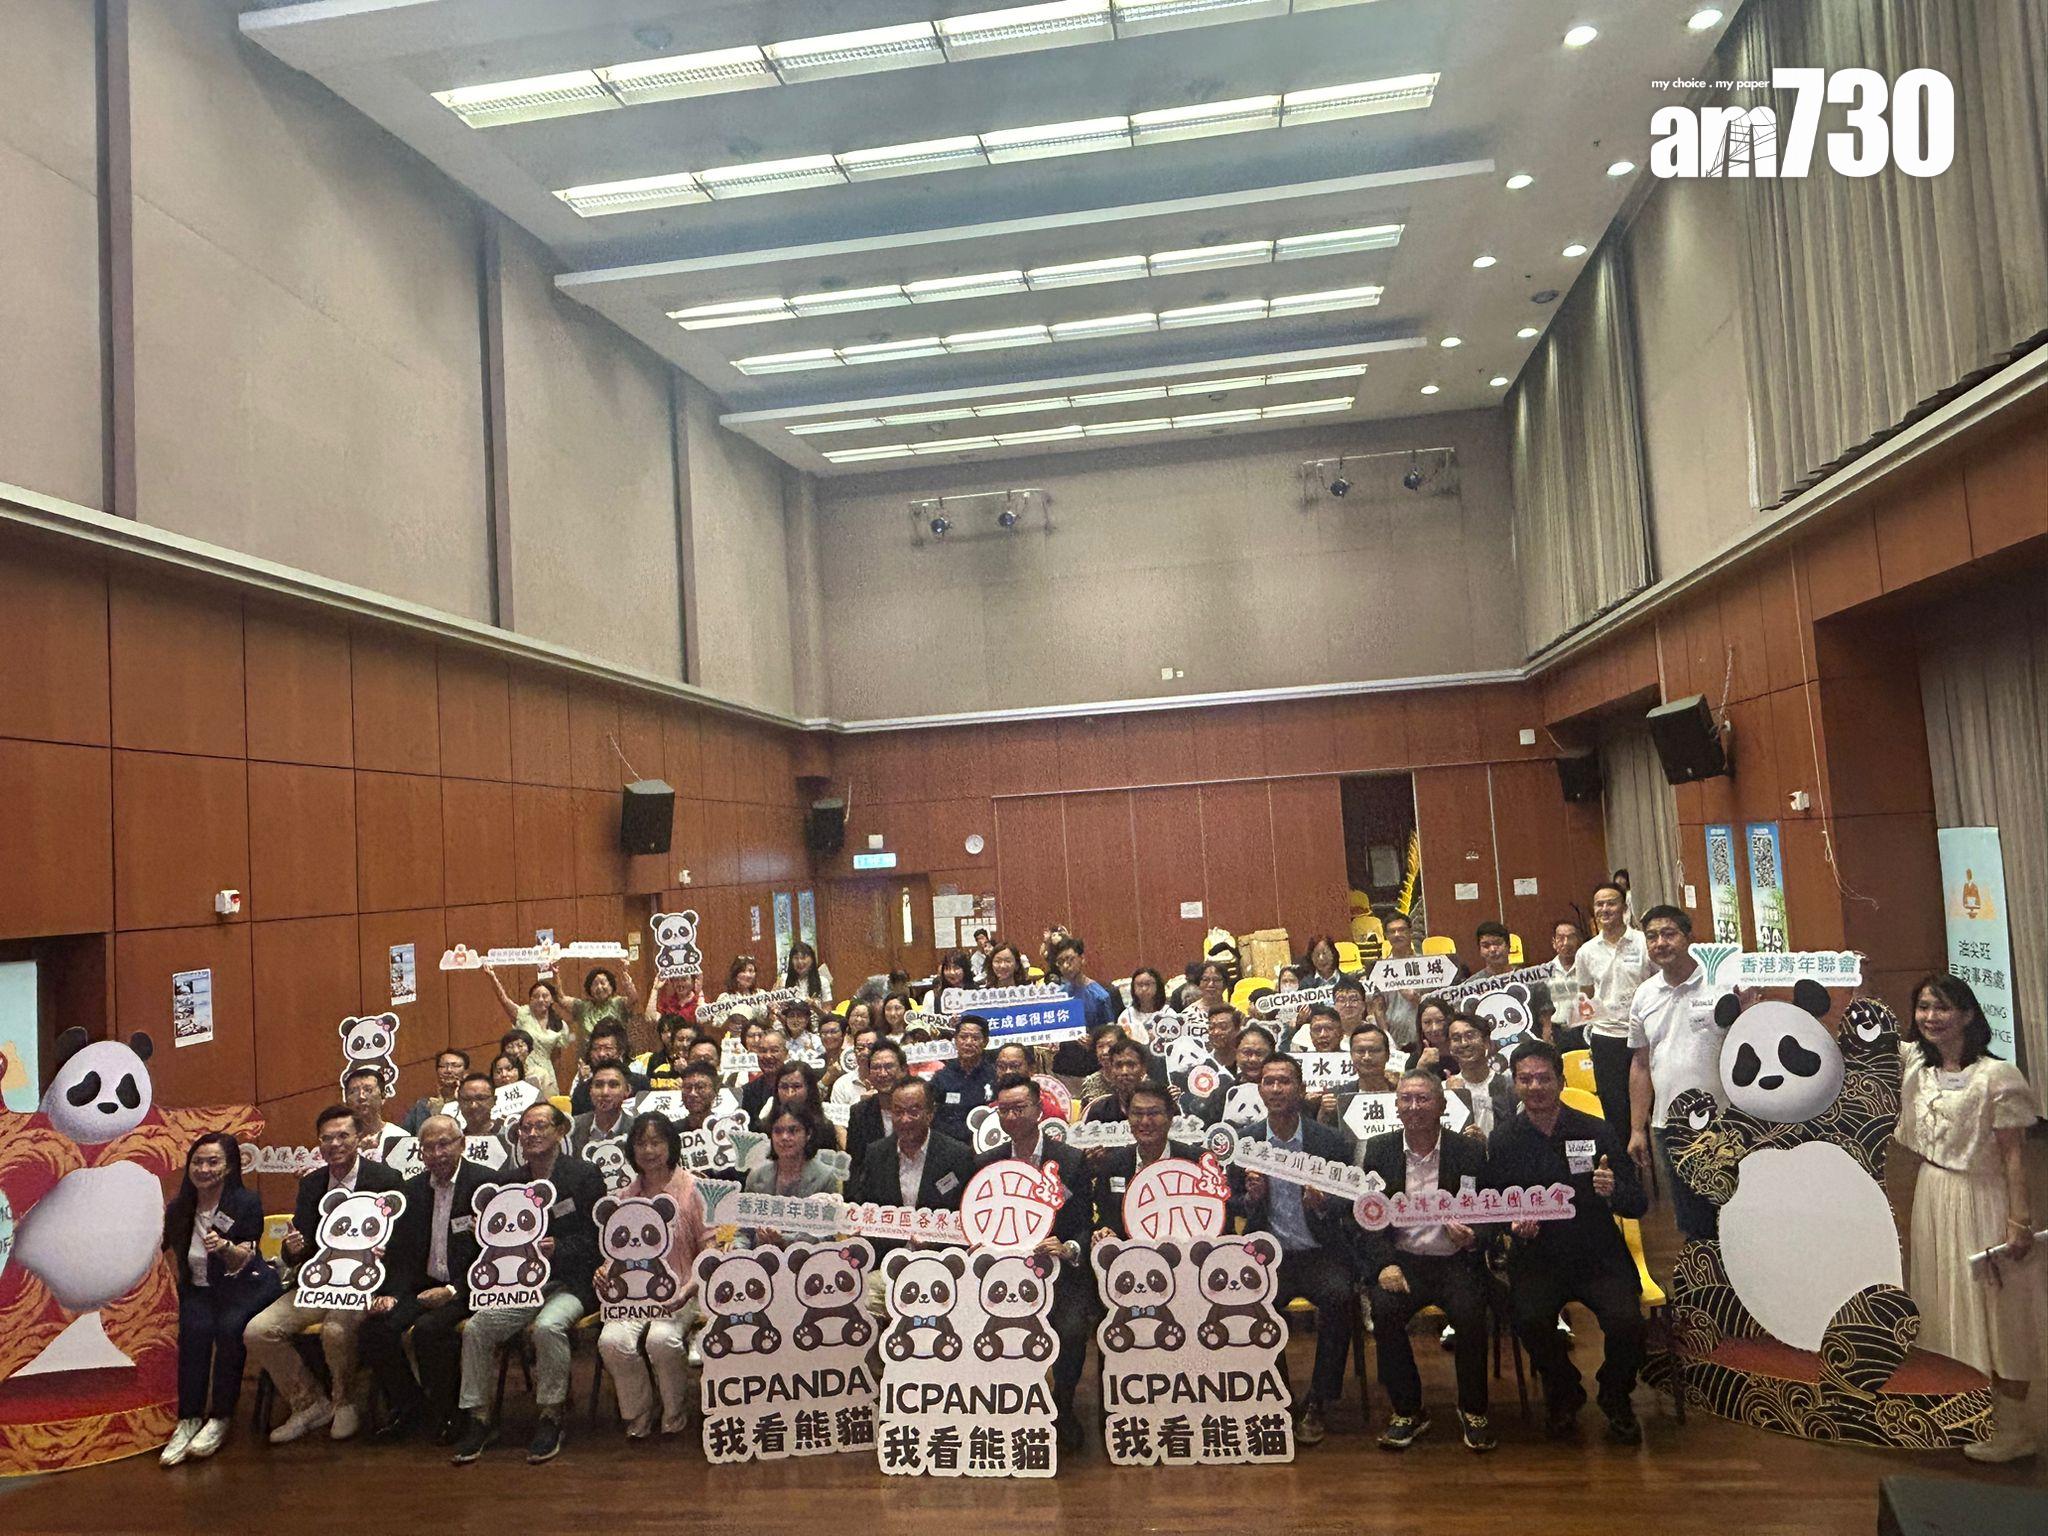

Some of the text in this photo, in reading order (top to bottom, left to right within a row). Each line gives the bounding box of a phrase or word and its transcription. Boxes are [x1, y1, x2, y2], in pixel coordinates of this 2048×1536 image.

[1383, 959, 1444, 978] 九龍城
[1740, 955, 1857, 974] 香港青年聯會
[1426, 976, 1444, 985] CITY
[1363, 1124, 1386, 1133] YAU
[682, 1133, 706, 1149] DA
[737, 1201, 837, 1222] 香港青年聯會
[298, 1290, 368, 1307] ICPANDA
[472, 1292, 540, 1306] ICPANDA
[604, 1305, 673, 1319] ICPANDA
[707, 1365, 872, 1408] ICPANDA
[1109, 1370, 1284, 1405] ICPANDA
[886, 1383, 1051, 1415] ICPANDA
[709, 1405, 875, 1457] 我看熊貓
[1112, 1413, 1287, 1458] 我看熊貓
[884, 1425, 1050, 1470] 我看熊貓
